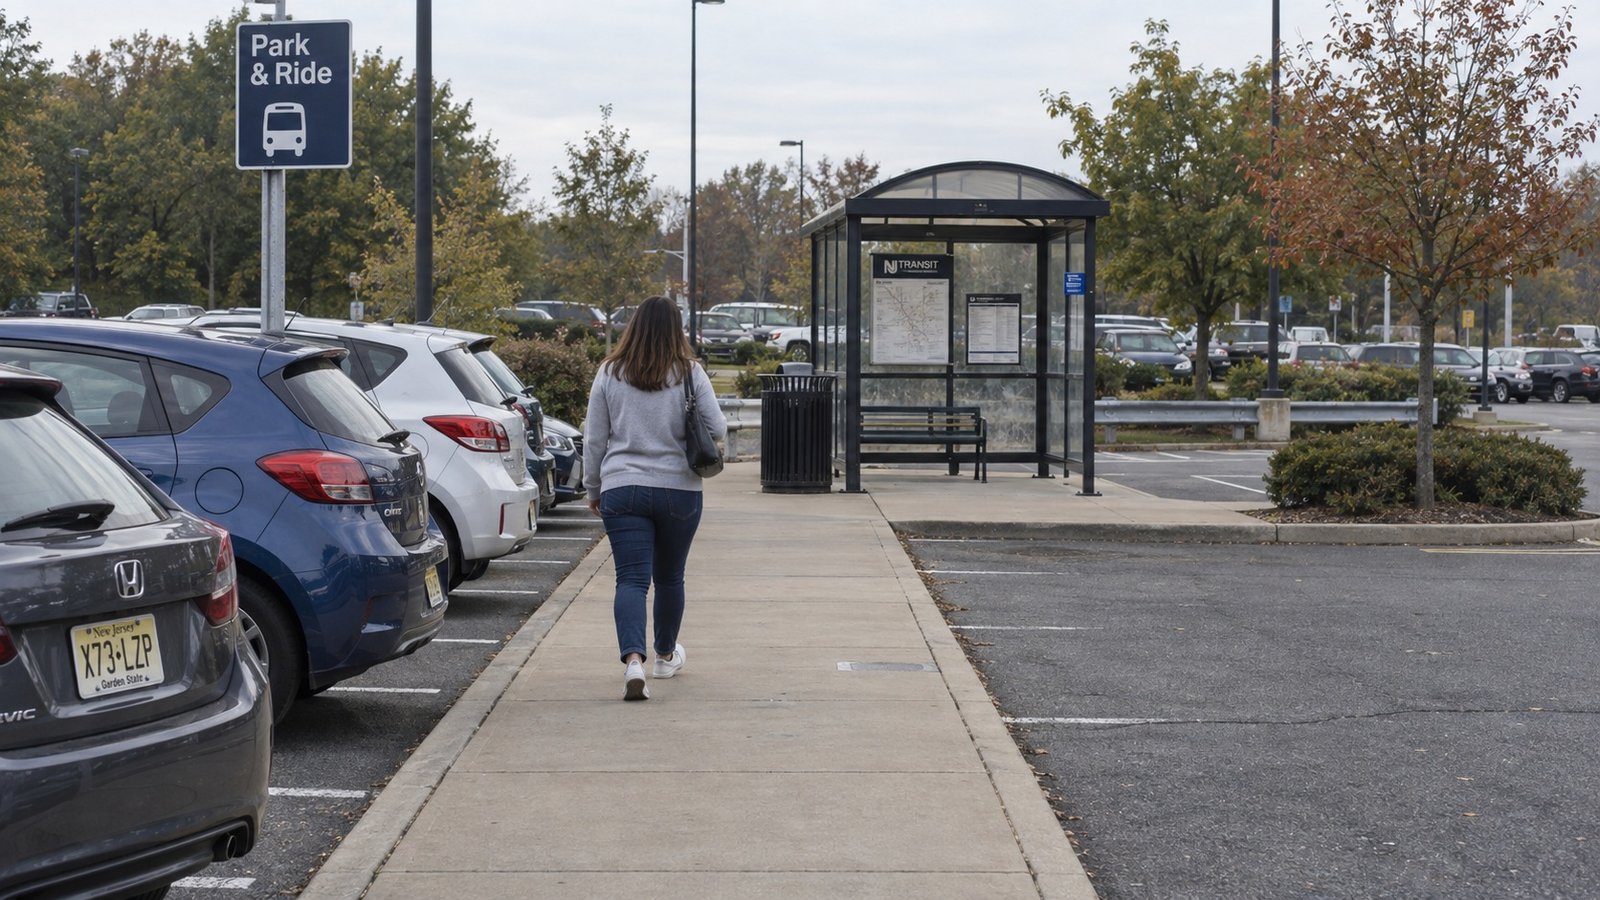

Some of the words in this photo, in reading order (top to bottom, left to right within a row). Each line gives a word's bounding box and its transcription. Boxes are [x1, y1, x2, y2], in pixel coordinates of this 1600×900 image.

[251, 32, 310, 57] Park
[250, 62, 269, 86] &
[275, 61, 333, 85] Ride
[883, 259, 898, 274] NJ
[898, 260, 939, 269] TRANSIT
[92, 626, 111, 638] New
[112, 623, 135, 637] Jersey
[101, 677, 125, 690] Garden
[126, 673, 143, 685] State
